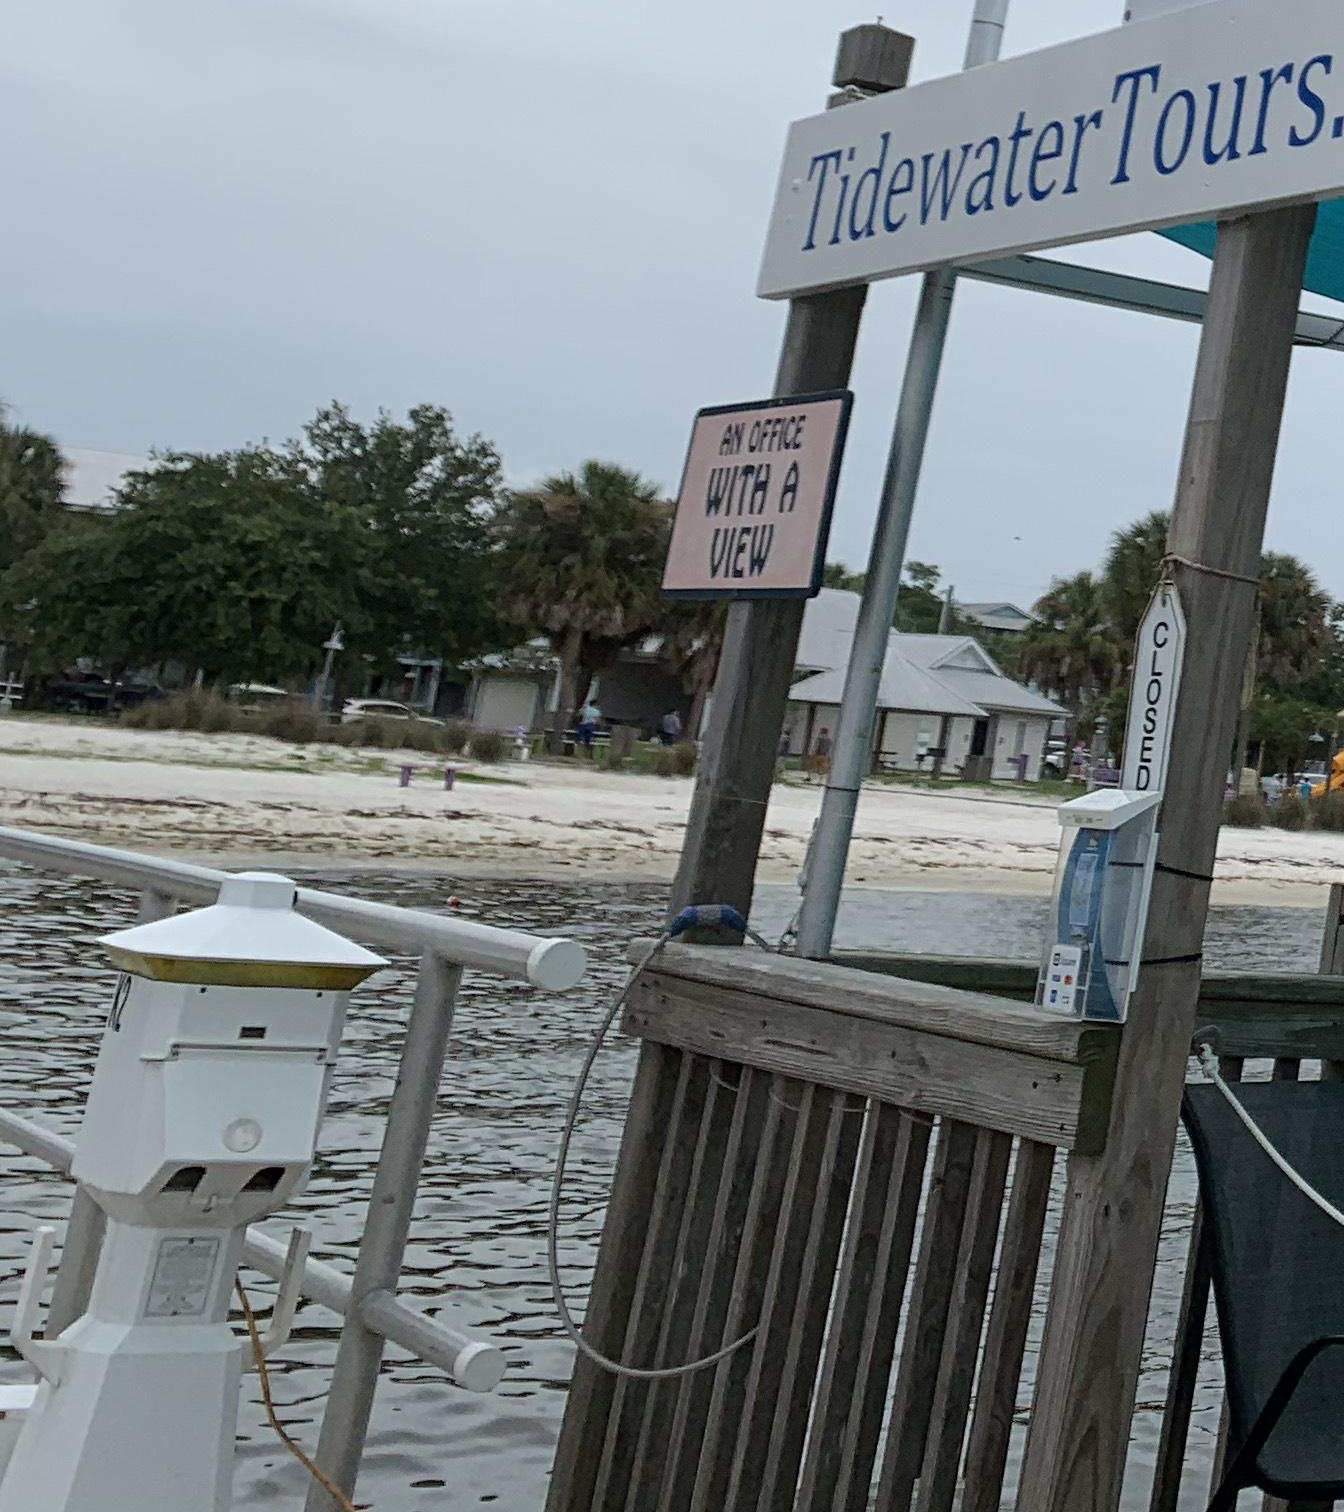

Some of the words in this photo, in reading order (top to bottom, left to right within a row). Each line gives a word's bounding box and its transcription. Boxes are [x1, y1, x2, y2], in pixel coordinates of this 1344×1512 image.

[719, 422, 746, 456] AN
[749, 415, 806, 453] OFFICE
[706, 463, 771, 517] WITH
[778, 460, 799, 513] A
[710, 524, 774, 578] VIEW
[1135, 621, 1168, 791] CLOSED
